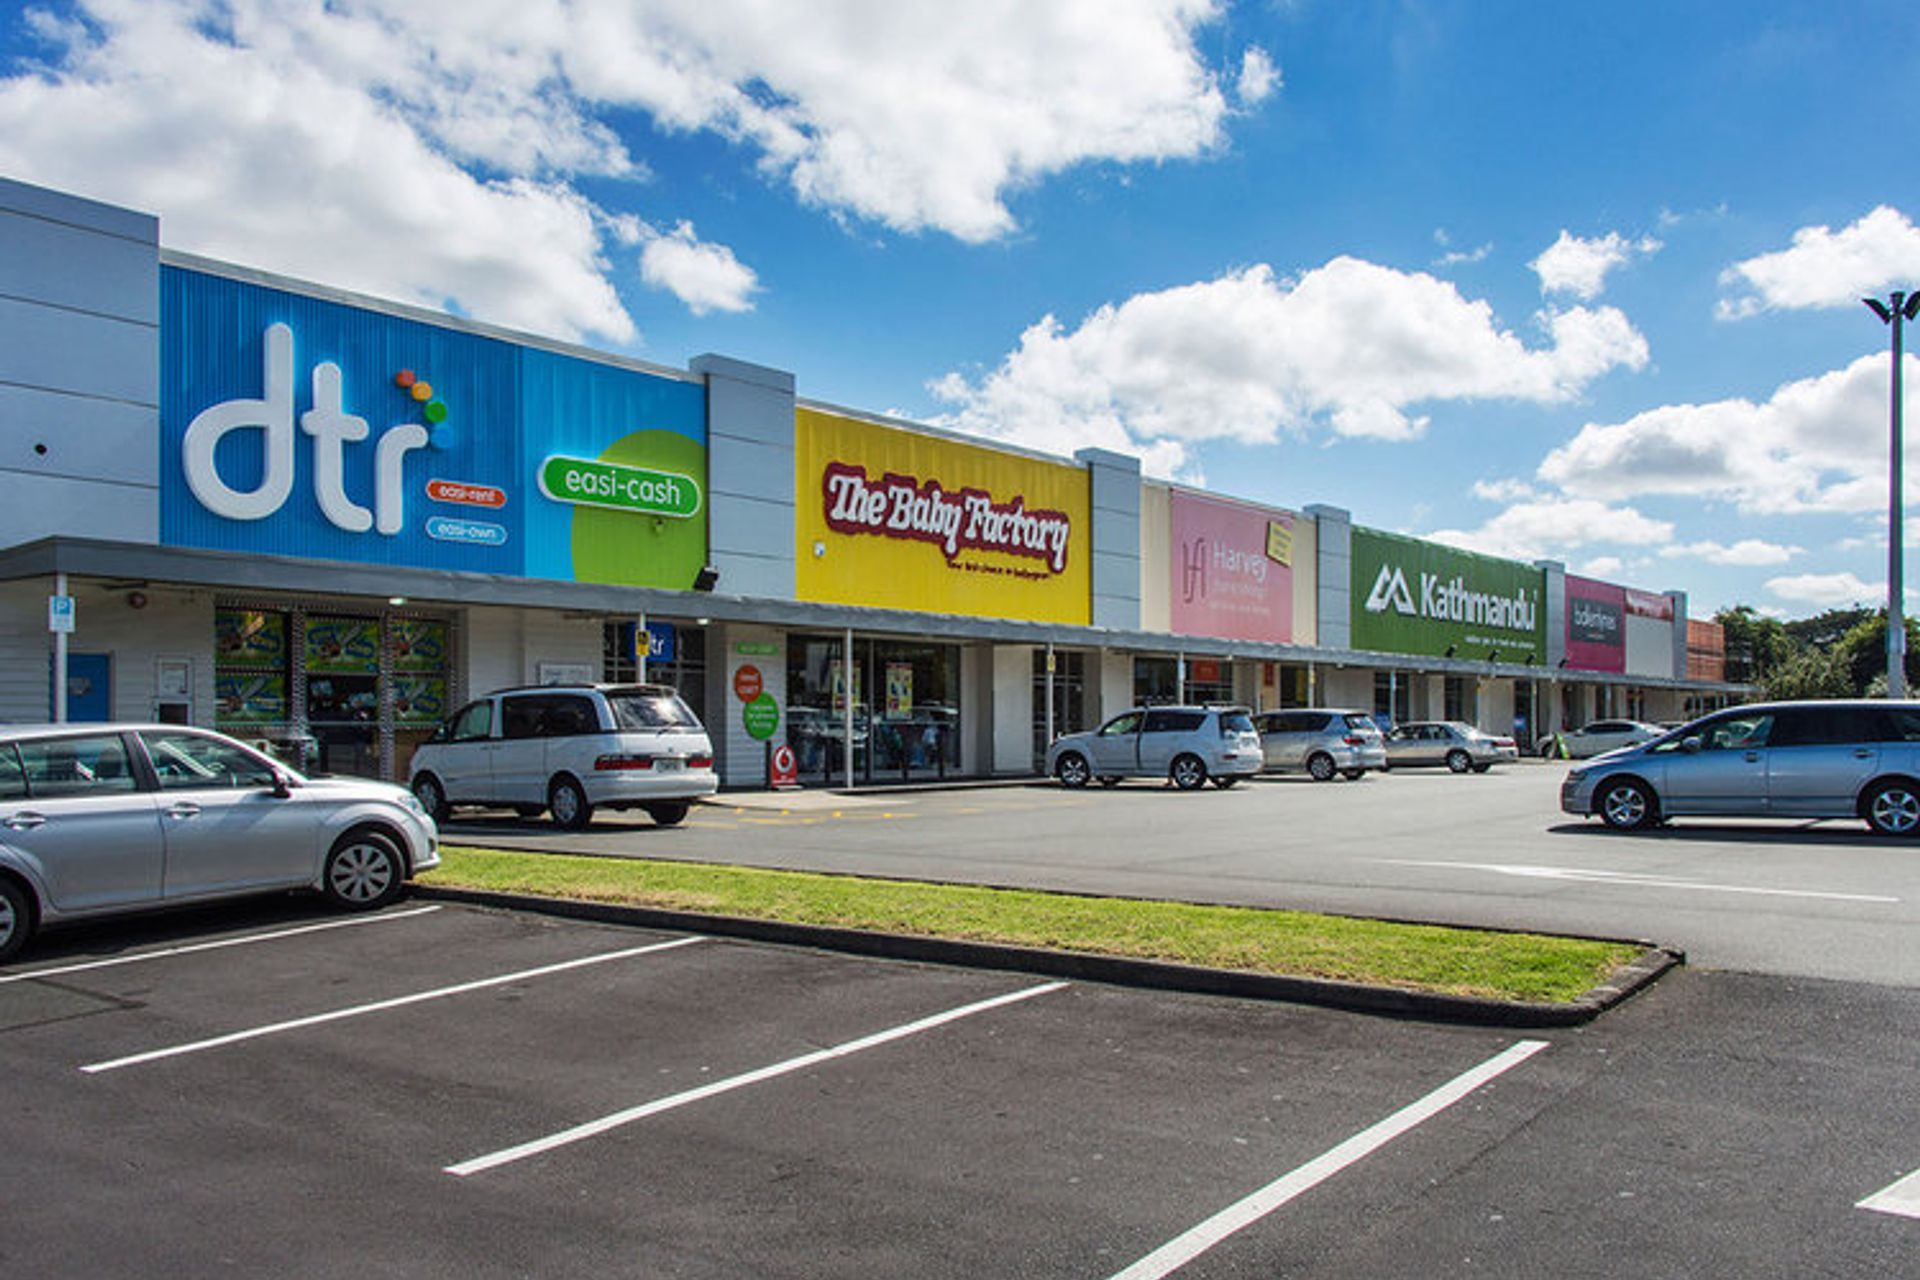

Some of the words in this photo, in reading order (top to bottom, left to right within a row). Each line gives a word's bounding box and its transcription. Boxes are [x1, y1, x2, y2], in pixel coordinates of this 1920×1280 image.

[182, 322, 429, 535] dtr
[564, 469, 681, 506] easi-cash
[437, 523, 497, 538] easi-own
[828, 474, 886, 526] The
[886, 485, 962, 554] Baby
[964, 495, 1069, 571] Factory
[1213, 540, 1268, 583] Harvey
[1420, 572, 1536, 631] Kathmandu
